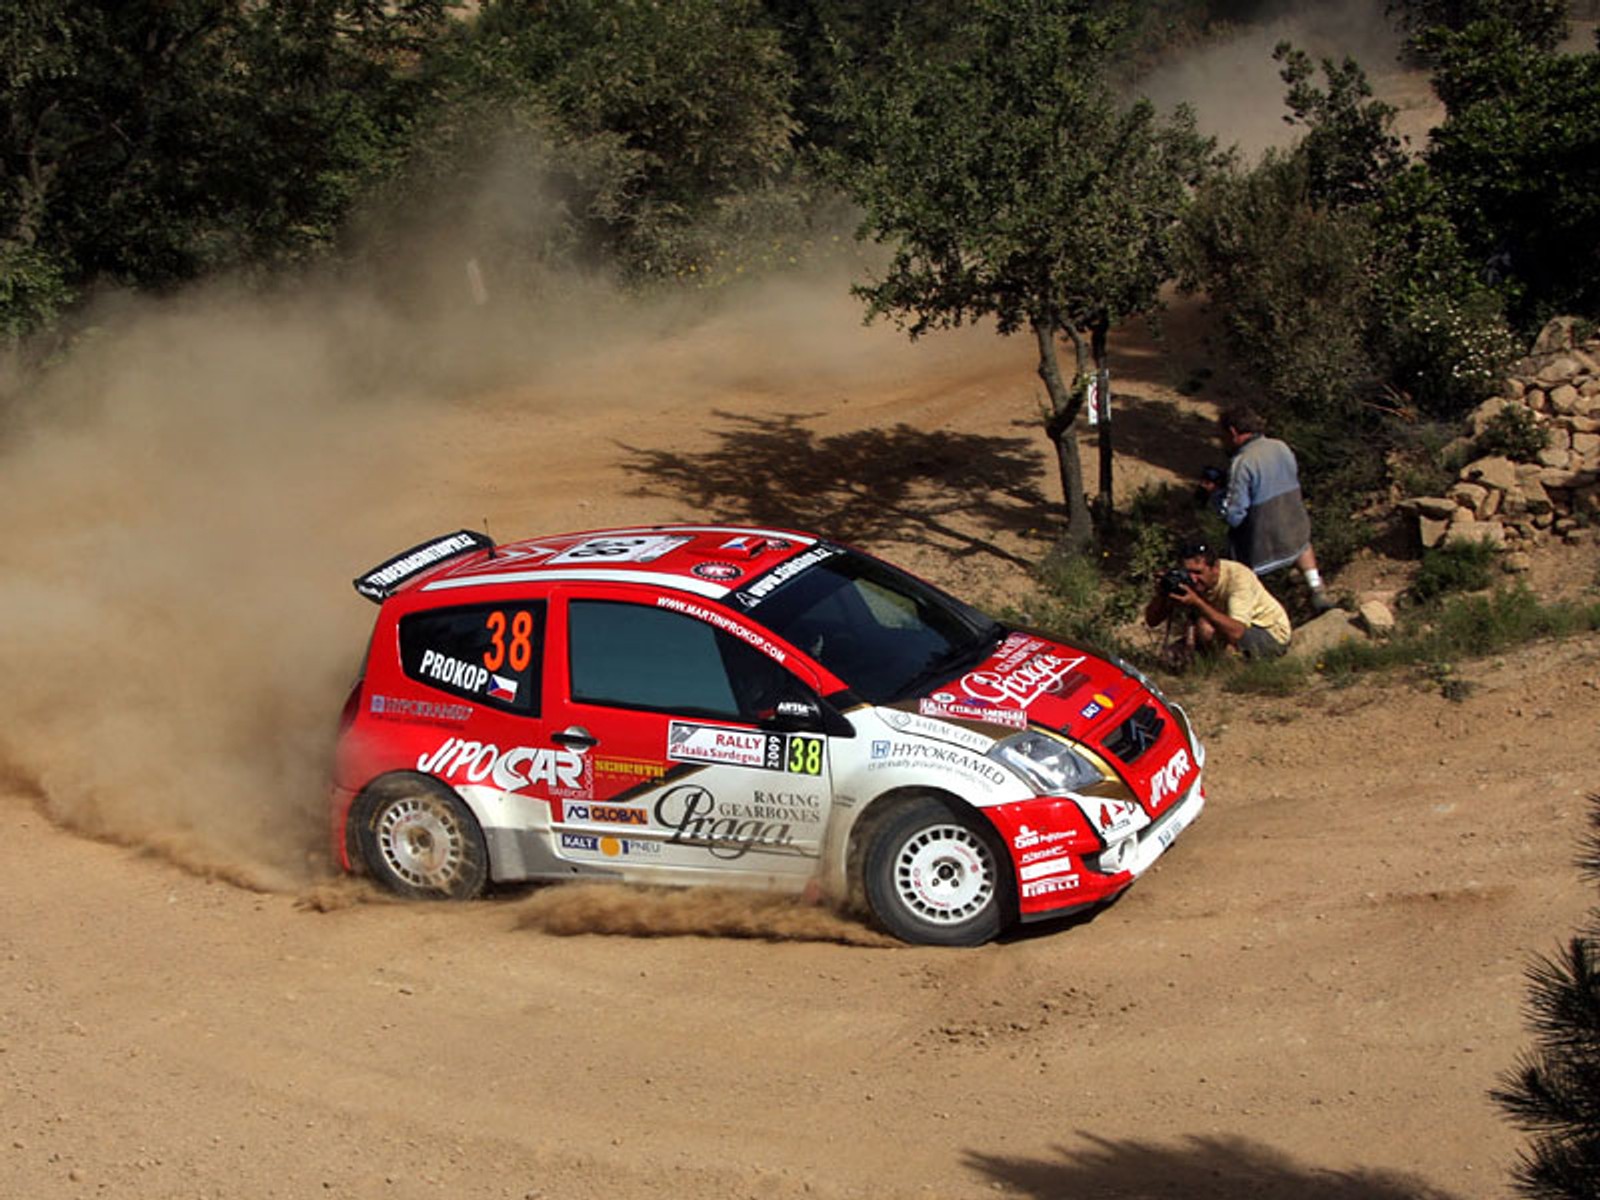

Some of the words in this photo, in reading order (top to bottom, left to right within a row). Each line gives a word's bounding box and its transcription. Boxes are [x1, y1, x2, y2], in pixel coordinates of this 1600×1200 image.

[484, 610, 533, 672] 38
[657, 597, 787, 664] WWW.MARTINPROKOP.COM
[419, 649, 489, 693] PROKOP
[710, 748, 761, 764] Sardegna
[715, 734, 762, 749] RALLY
[767, 736, 781, 768] 2009
[789, 737, 821, 775] 38
[891, 742, 1006, 786] HYPOKRAMED
[718, 802, 820, 823] GEARBOXES
[753, 790, 820, 808] RACING
[591, 806, 648, 825] GLOBAL
